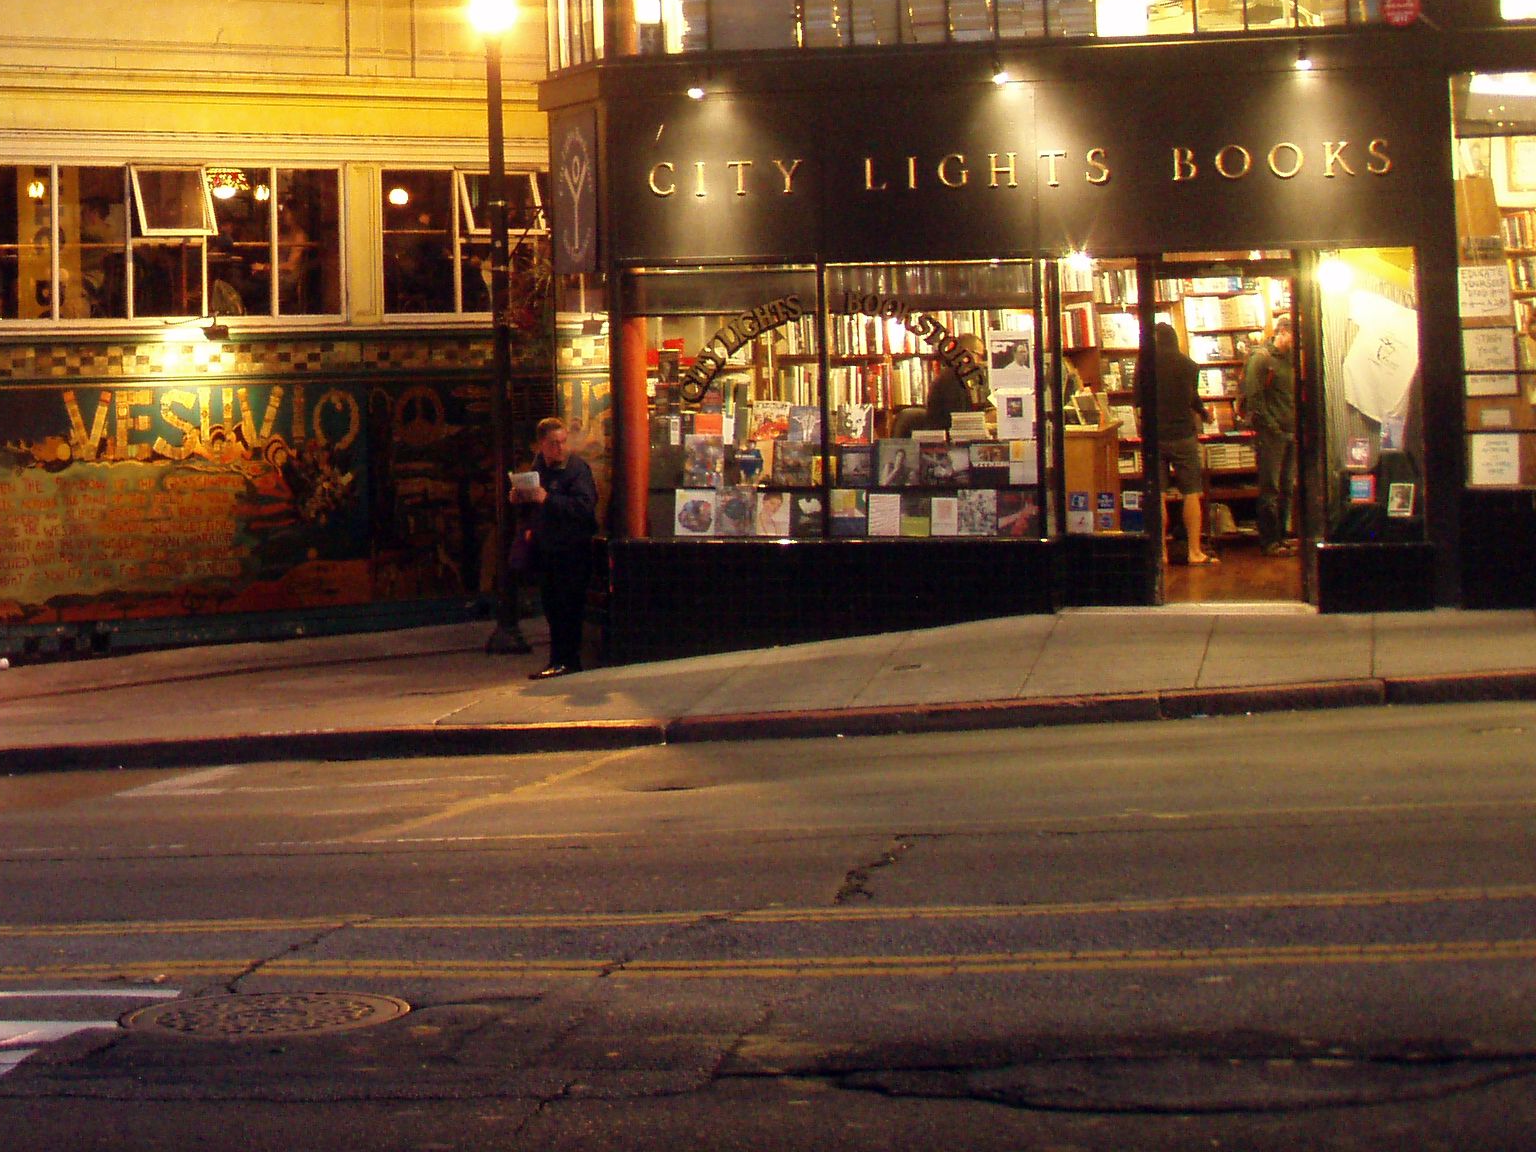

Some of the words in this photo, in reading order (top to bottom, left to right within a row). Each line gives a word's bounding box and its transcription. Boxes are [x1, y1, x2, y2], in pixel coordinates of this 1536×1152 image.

[648, 159, 803, 198] CITY
[865, 148, 1111, 191] LIGHTS
[1171, 138, 1394, 182] BOOKS
[680, 338, 728, 403] CITY
[717, 294, 805, 358] LIGHTS
[64, 386, 361, 460] VESUVIO
